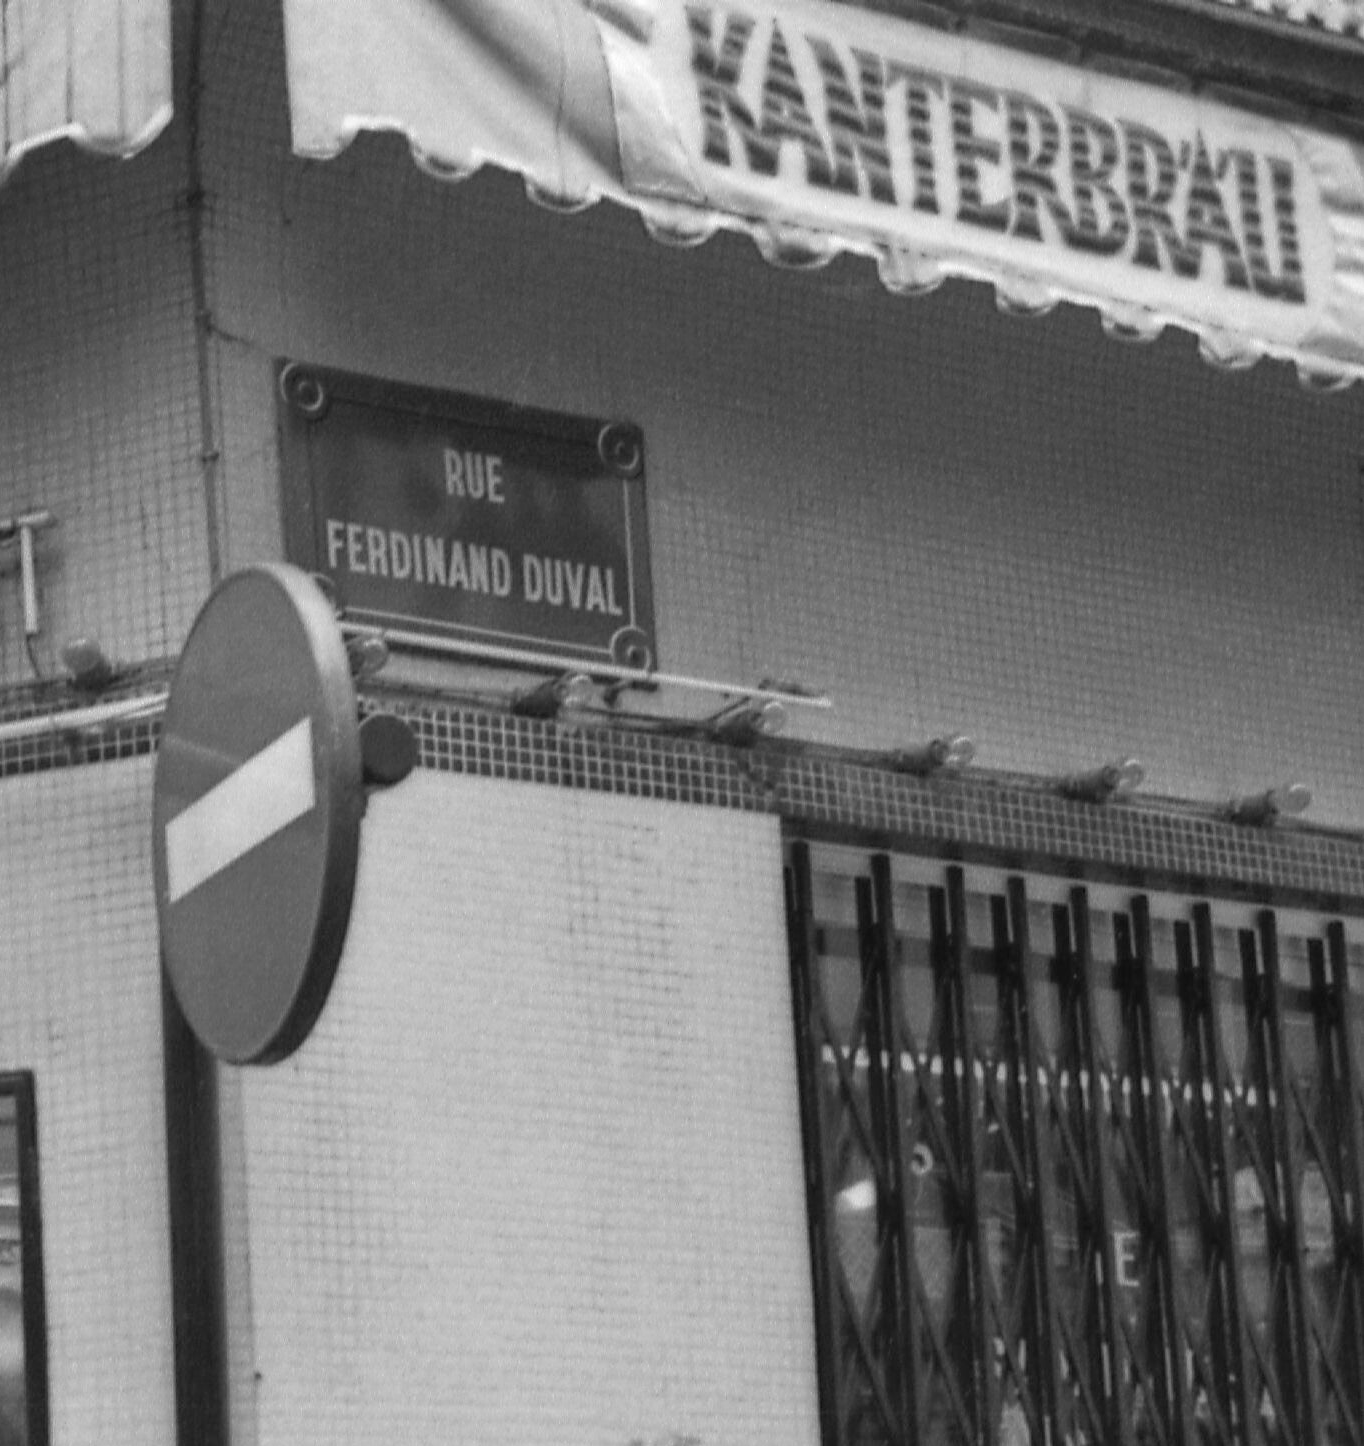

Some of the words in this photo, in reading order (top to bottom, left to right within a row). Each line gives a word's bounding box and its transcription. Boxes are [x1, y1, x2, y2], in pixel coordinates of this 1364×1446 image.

[444, 447, 505, 504] RUE
[325, 520, 512, 598] FERDINAND
[523, 552, 624, 617] DUVAL
